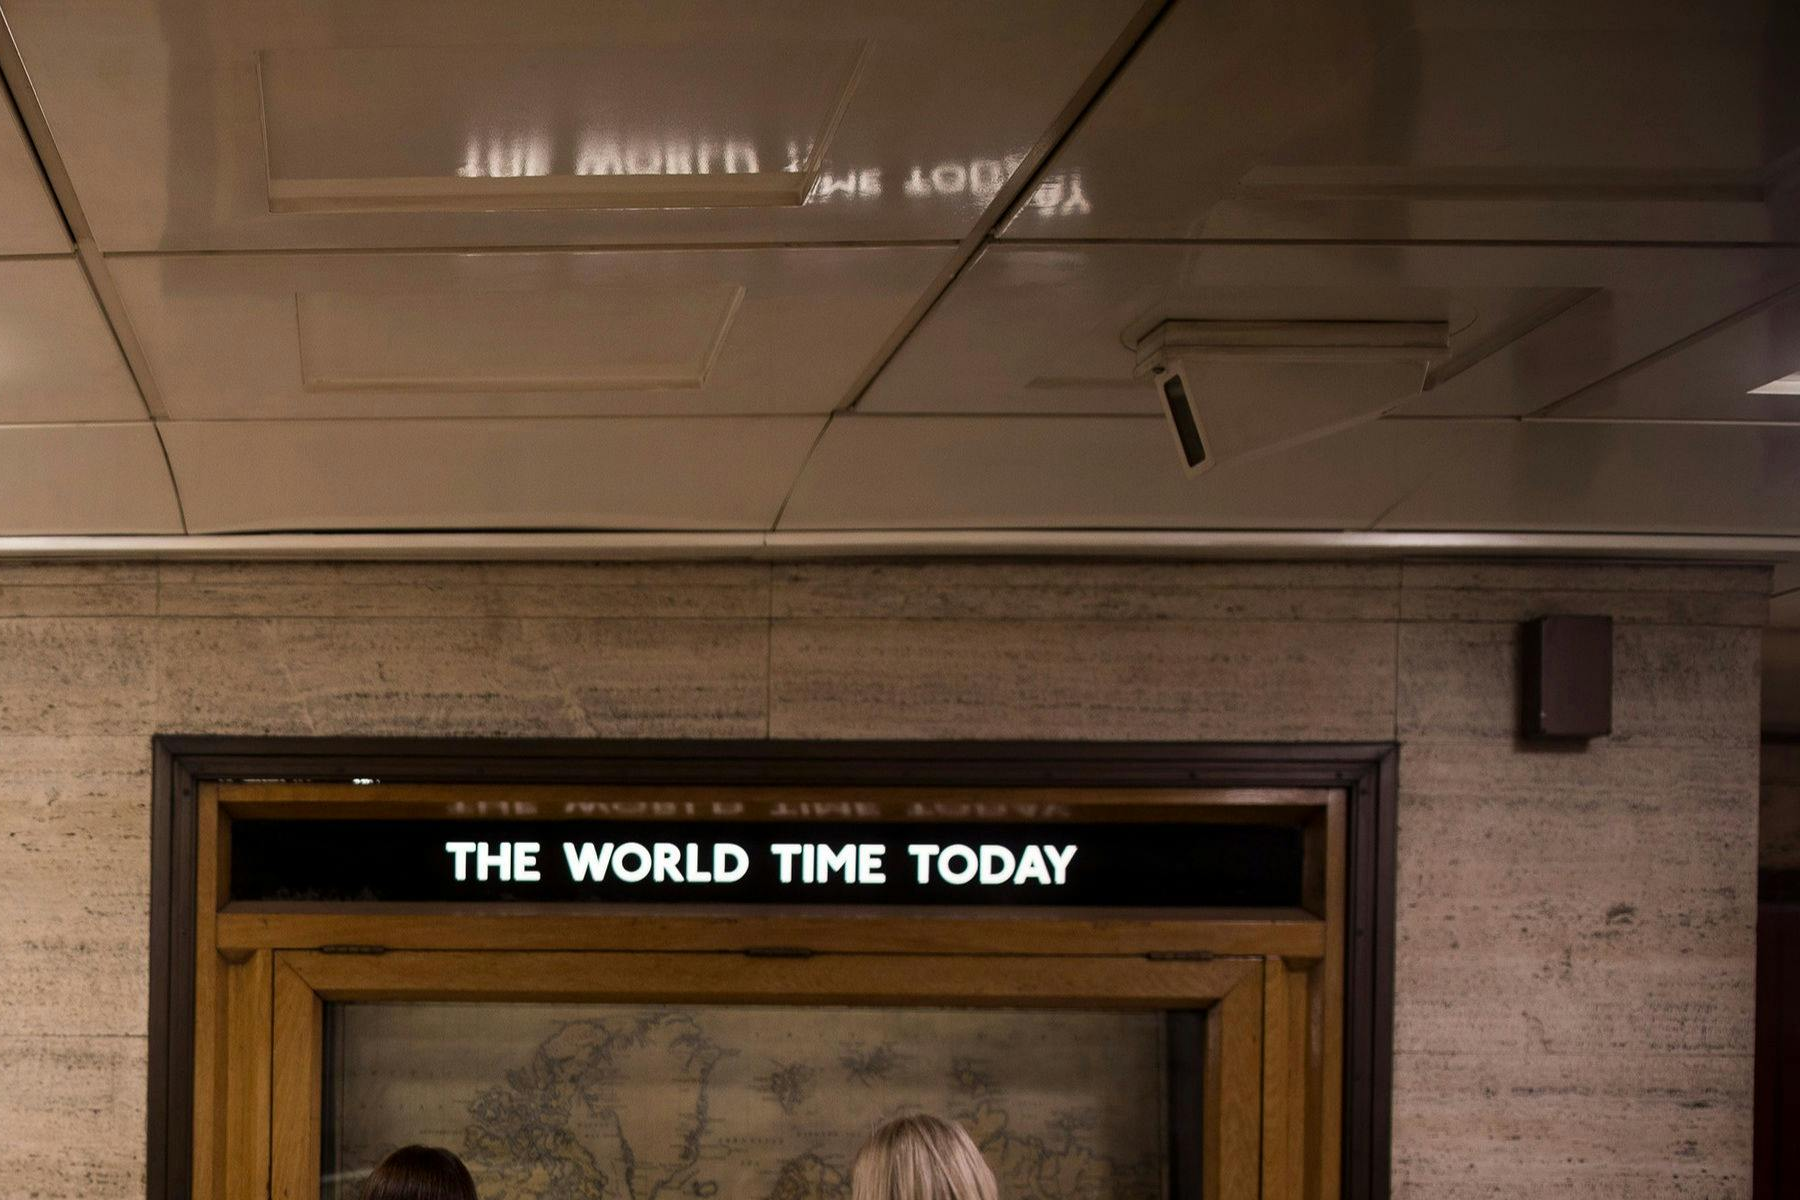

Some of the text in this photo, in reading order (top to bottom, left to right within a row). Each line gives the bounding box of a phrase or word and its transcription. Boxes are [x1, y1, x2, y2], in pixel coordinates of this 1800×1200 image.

[446, 842, 1078, 885] THE WORLD TIME TODAY
